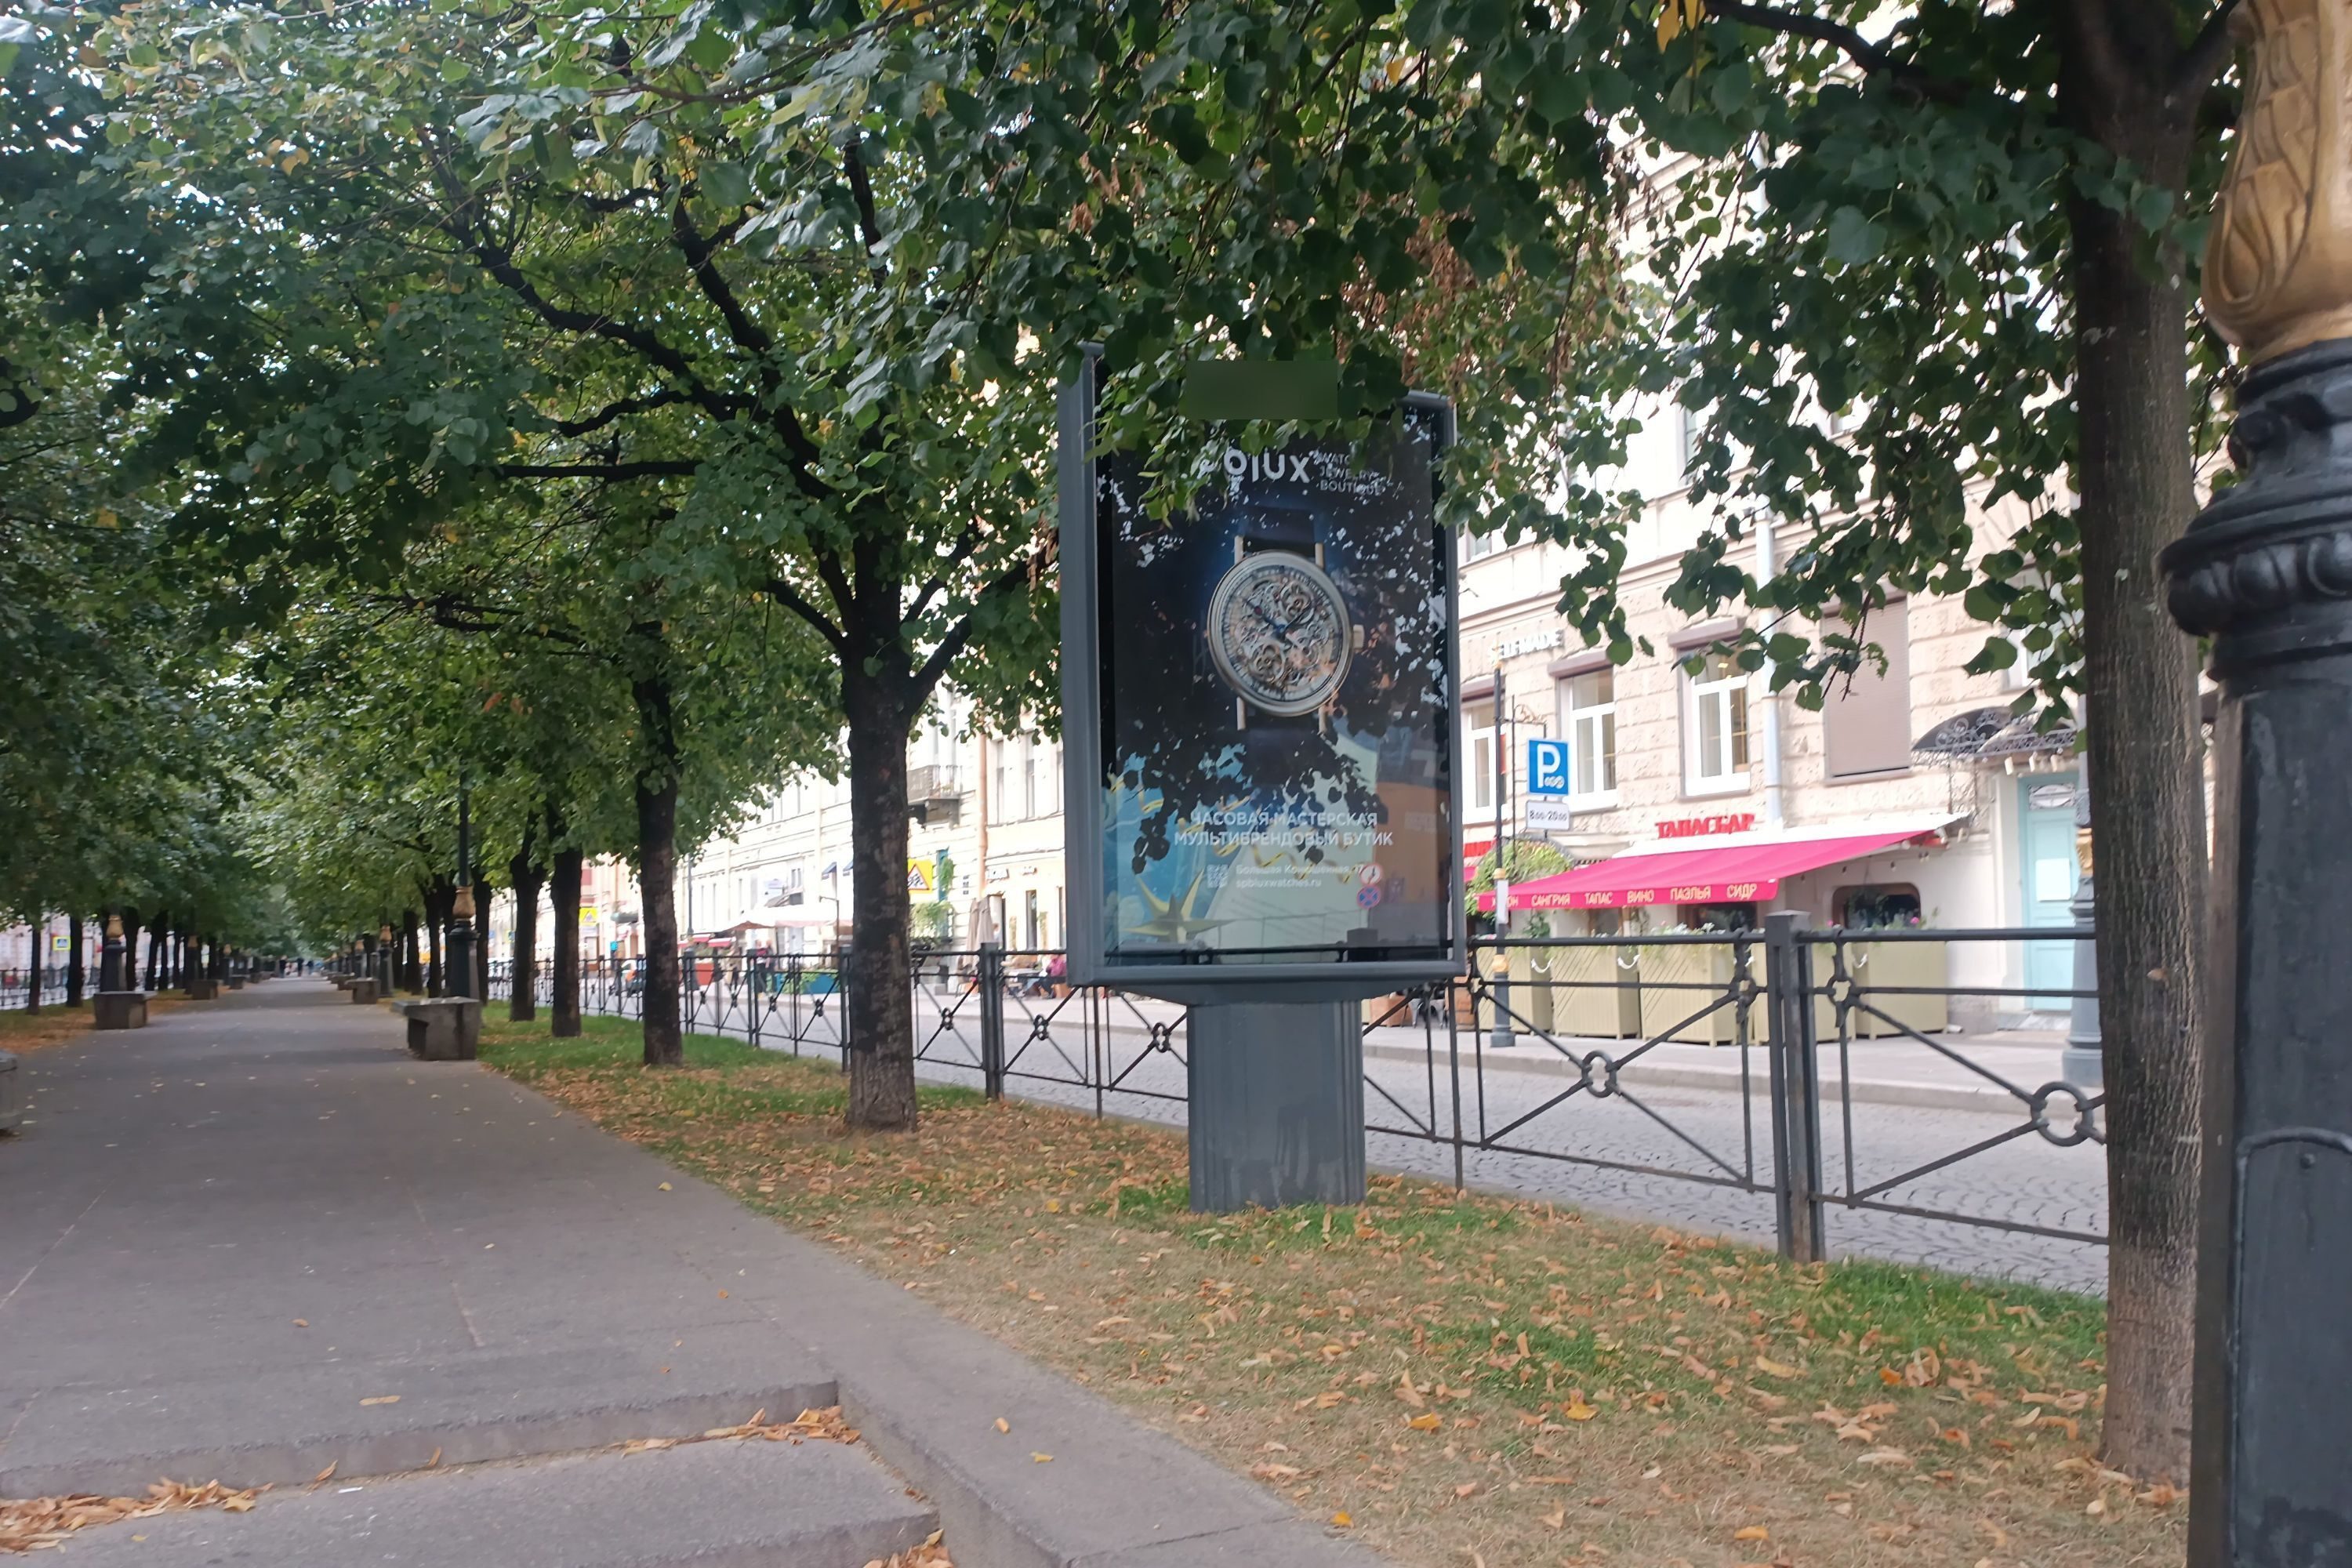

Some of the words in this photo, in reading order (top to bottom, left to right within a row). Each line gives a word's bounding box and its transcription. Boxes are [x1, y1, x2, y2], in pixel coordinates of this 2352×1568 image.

[1190, 812, 1269, 826] ЧАСОВАЯ
[1274, 812, 1377, 827] МАСТЕРСКАЯ
[1174, 830, 1338, 847] МУЛЬТИБРЕНДОВЫЙ
[1343, 831, 1393, 847] БУТИК
[1531, 893, 1570, 906] САНГРИЯ
[1584, 891, 1613, 906] ТАПАС
[1627, 889, 1655, 904] ВИНО
[1670, 885, 1711, 901] ПАЭЛЬЯ
[1726, 883, 1757, 901] СИДР
